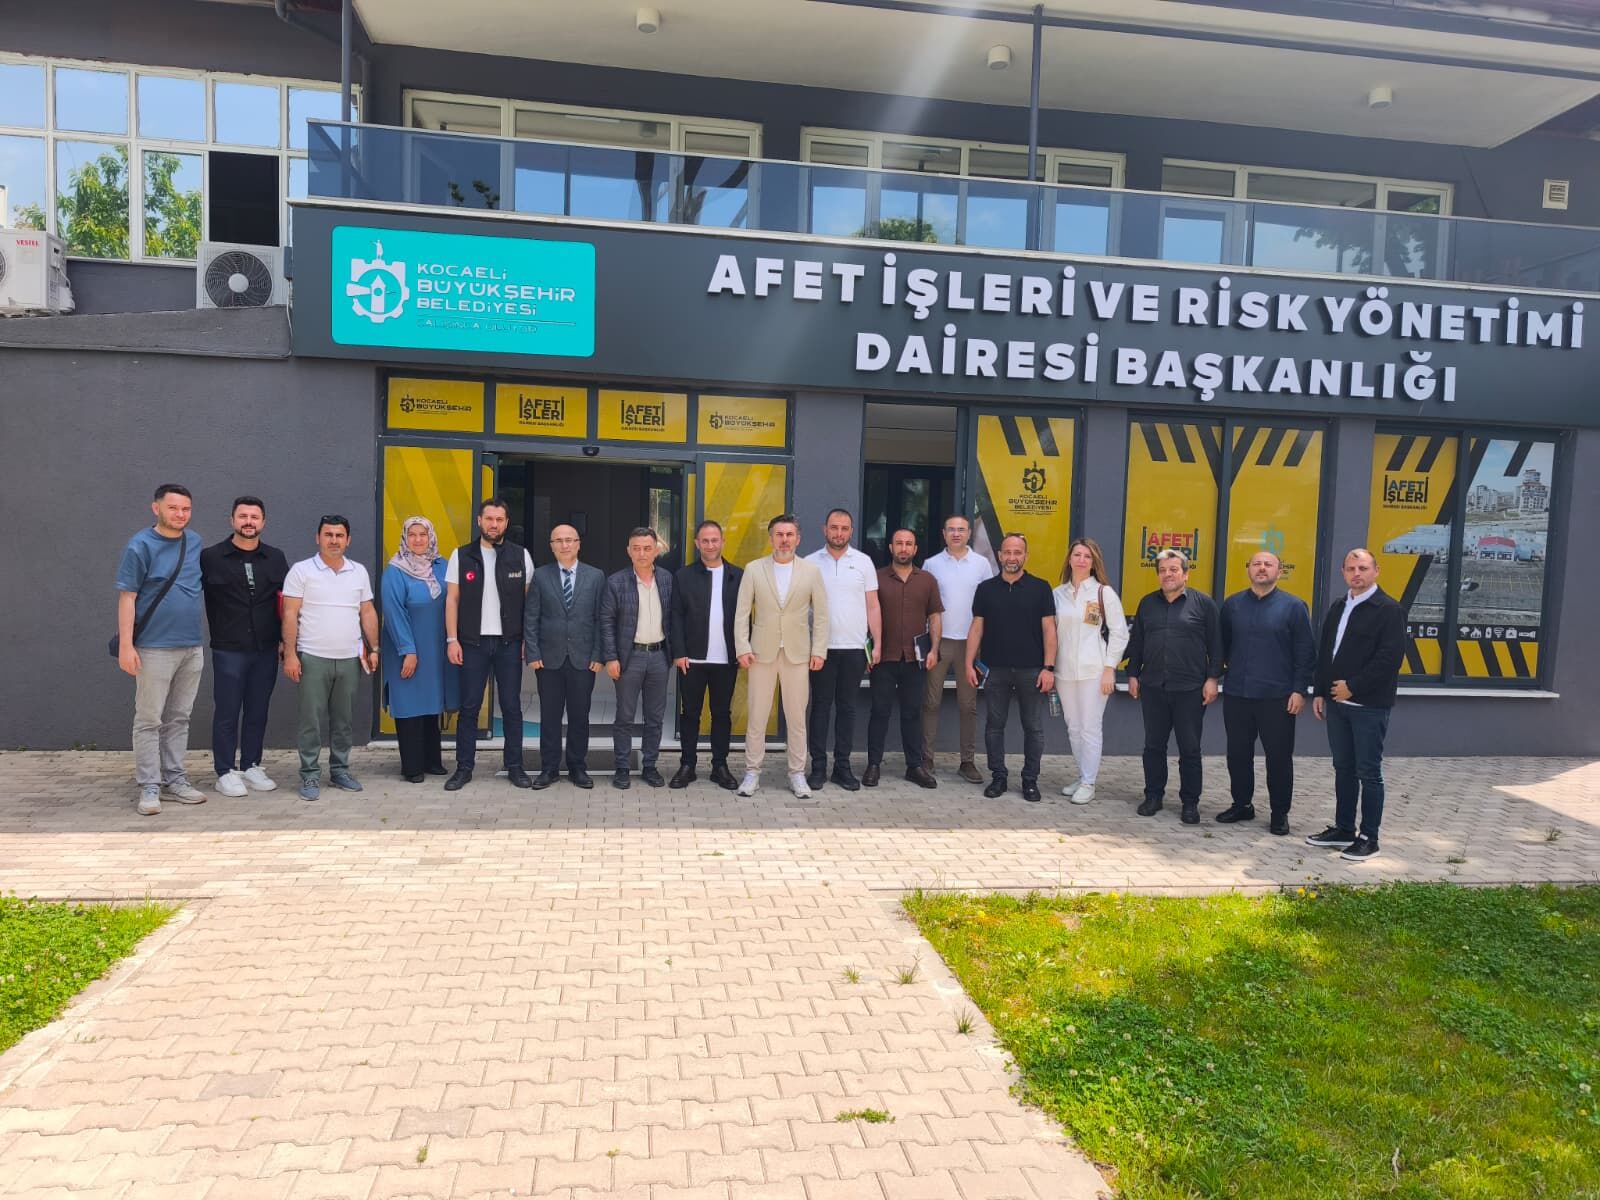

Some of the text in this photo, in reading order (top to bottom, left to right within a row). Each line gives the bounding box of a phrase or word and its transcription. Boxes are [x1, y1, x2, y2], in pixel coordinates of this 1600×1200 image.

[16, 239, 40, 247] VESTEL
[416, 263, 507, 281] KOCAELİ
[416, 279, 576, 303] BÜYÜKŞEHİR
[416, 297, 537, 316] BELEDİYESİ
[707, 252, 1585, 349] AFET İŞLERİ VE RİSK YÖNETİMİ
[855, 323, 1457, 403] DAİRESİ BAŞKANLIĞI
[523, 398, 560, 410] AFET
[625, 404, 661, 416] AFET
[1388, 479, 1425, 492] AFET
[1147, 532, 1194, 546] AFET
